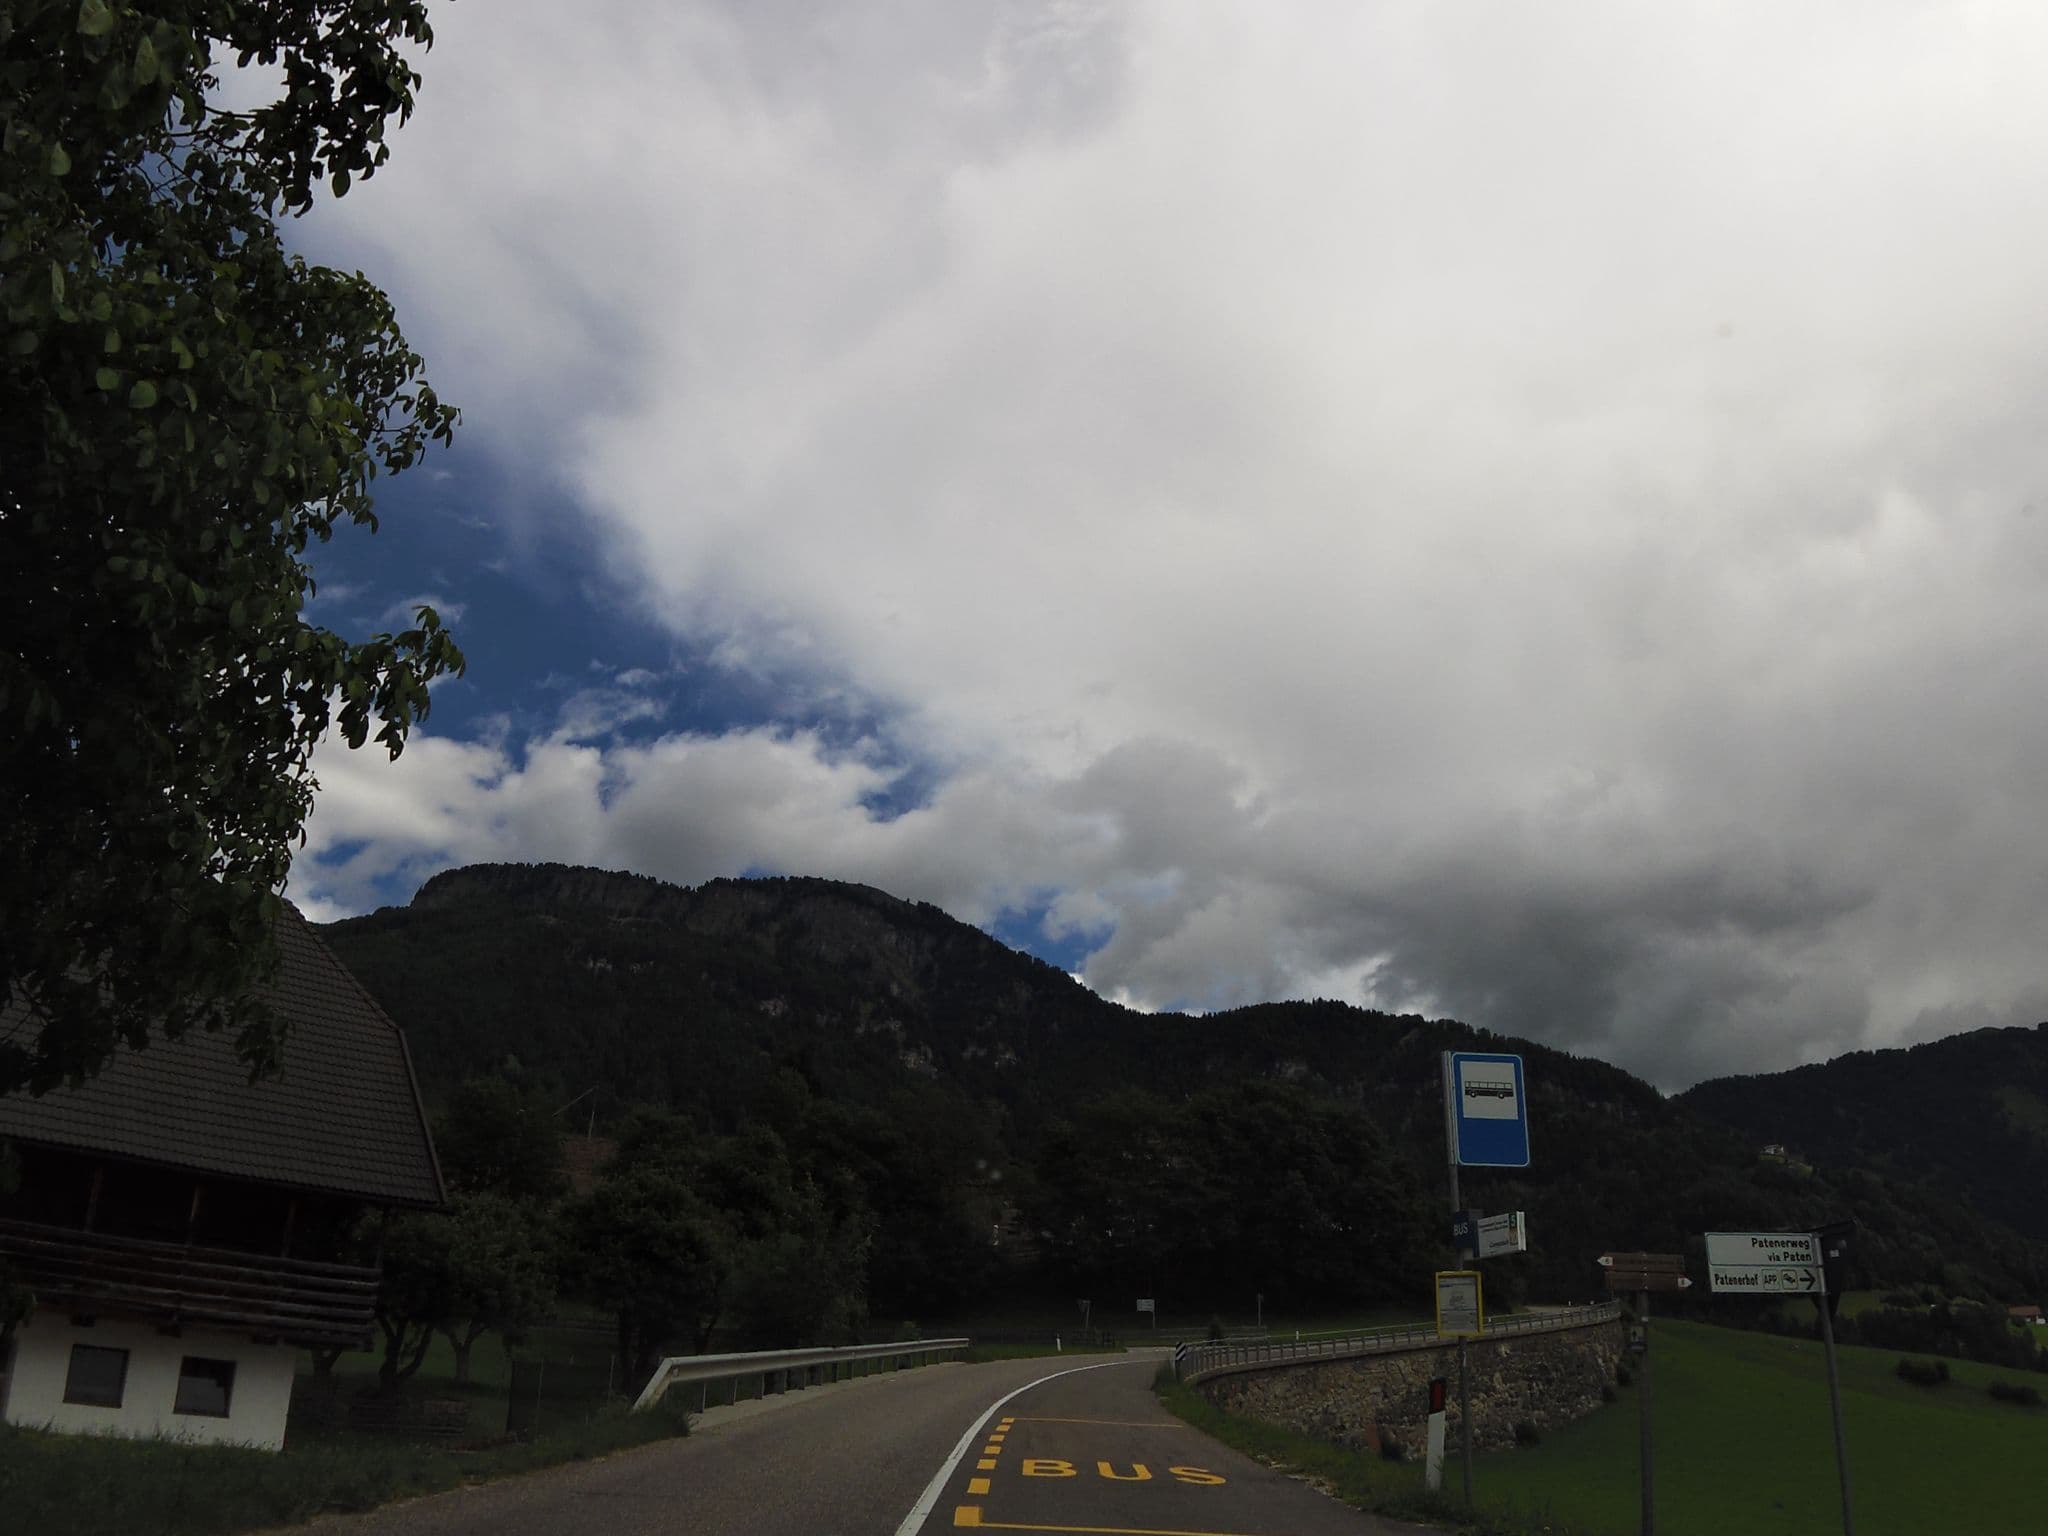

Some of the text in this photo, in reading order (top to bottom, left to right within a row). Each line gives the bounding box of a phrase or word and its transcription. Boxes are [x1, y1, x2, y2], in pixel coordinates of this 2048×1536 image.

[1454, 1222, 1468, 1236] BUS
[1751, 1238, 1810, 1250] Patenerweg
[1767, 1252, 1812, 1262] via Paten
[1714, 1273, 1758, 1286] Patenerhof
[1021, 1458, 1227, 1485] BUS
